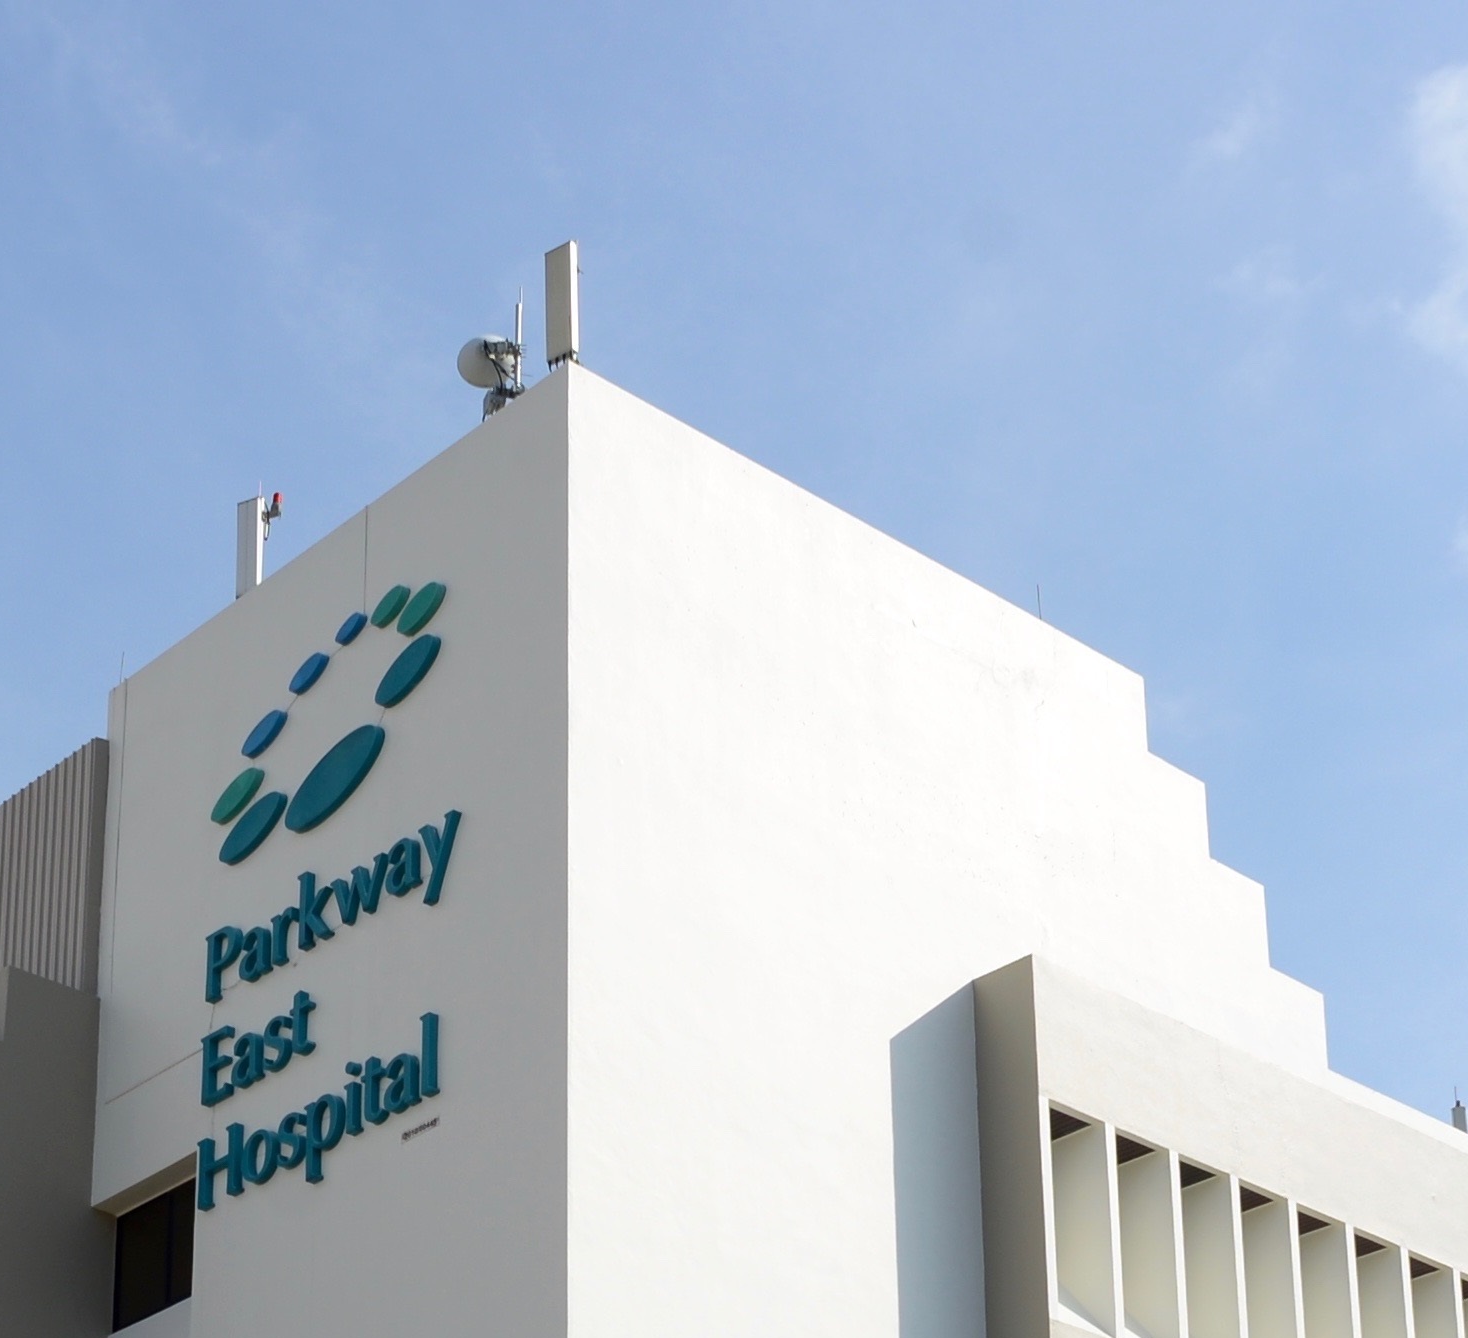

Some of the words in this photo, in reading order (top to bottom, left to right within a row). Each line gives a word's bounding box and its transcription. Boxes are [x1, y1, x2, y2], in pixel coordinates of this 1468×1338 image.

[205, 809, 462, 1004] Parkway
[196, 1012, 440, 1211] Hospital
[200, 990, 316, 1107] East
